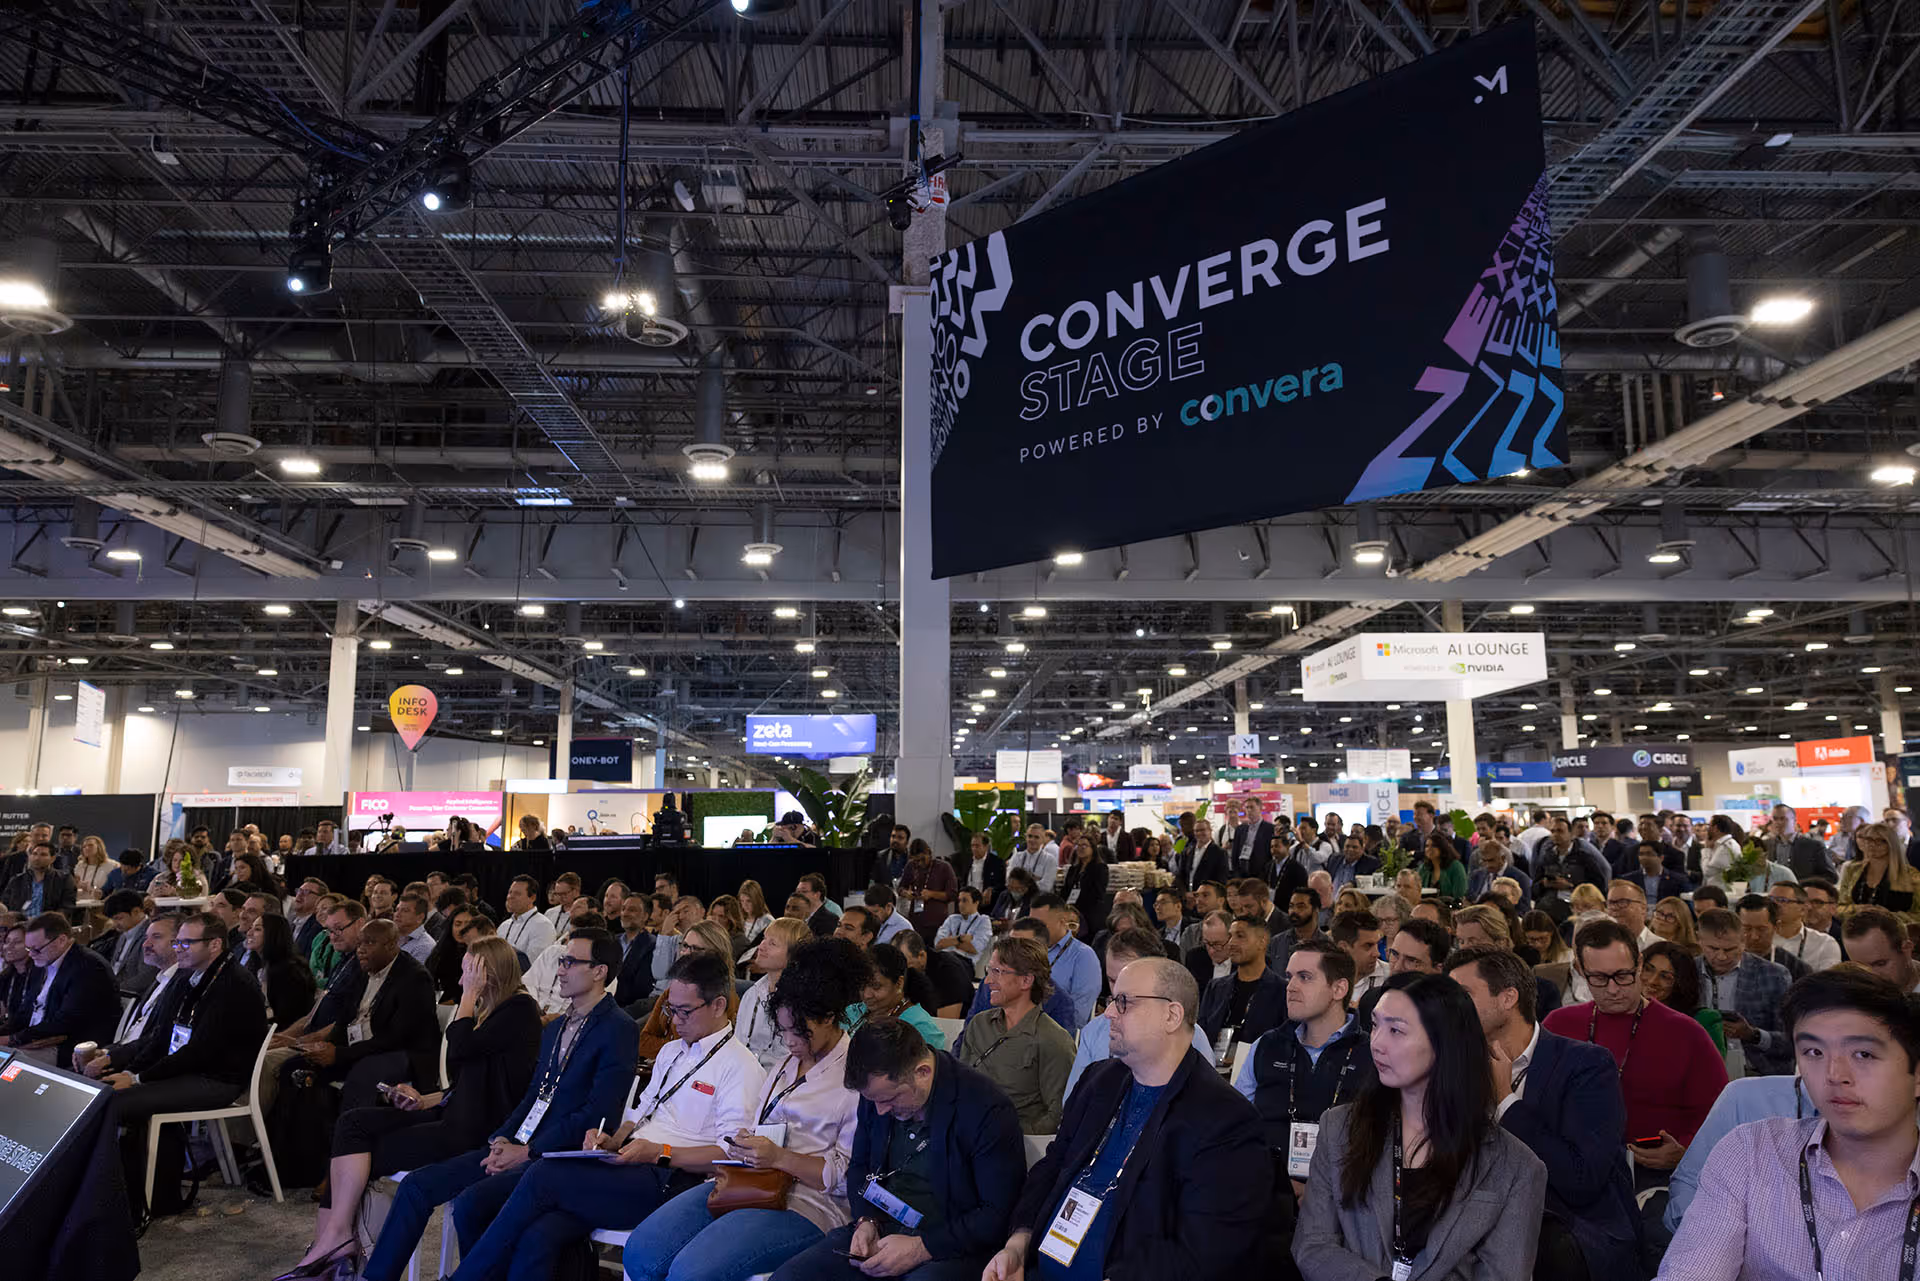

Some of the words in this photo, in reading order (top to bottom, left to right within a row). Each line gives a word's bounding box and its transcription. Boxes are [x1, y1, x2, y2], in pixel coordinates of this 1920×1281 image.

[1019, 197, 1389, 362] CONVERGE
[1019, 322, 1205, 422] STAGE
[1019, 423, 1125, 463] POWERED
[1136, 412, 1165, 434] BY
[1178, 361, 1344, 427] convera
[1393, 643, 1439, 655] Microsoft
[1447, 643, 1463, 656] AI
[1467, 643, 1529, 656] LOUNGE
[1467, 664, 1505, 673] NVIDIA
[399, 697, 428, 706] INFO
[397, 707, 428, 717] DESK
[752, 722, 793, 739] zeta
[571, 756, 619, 765] ONEY-BOT
[1556, 755, 1588, 768] CIRCLE
[1652, 753, 1688, 765] CIRCLE
[1777, 758, 1799, 769] Alip
[1328, 787, 1350, 797] NICE
[360, 799, 389, 811] FICO
